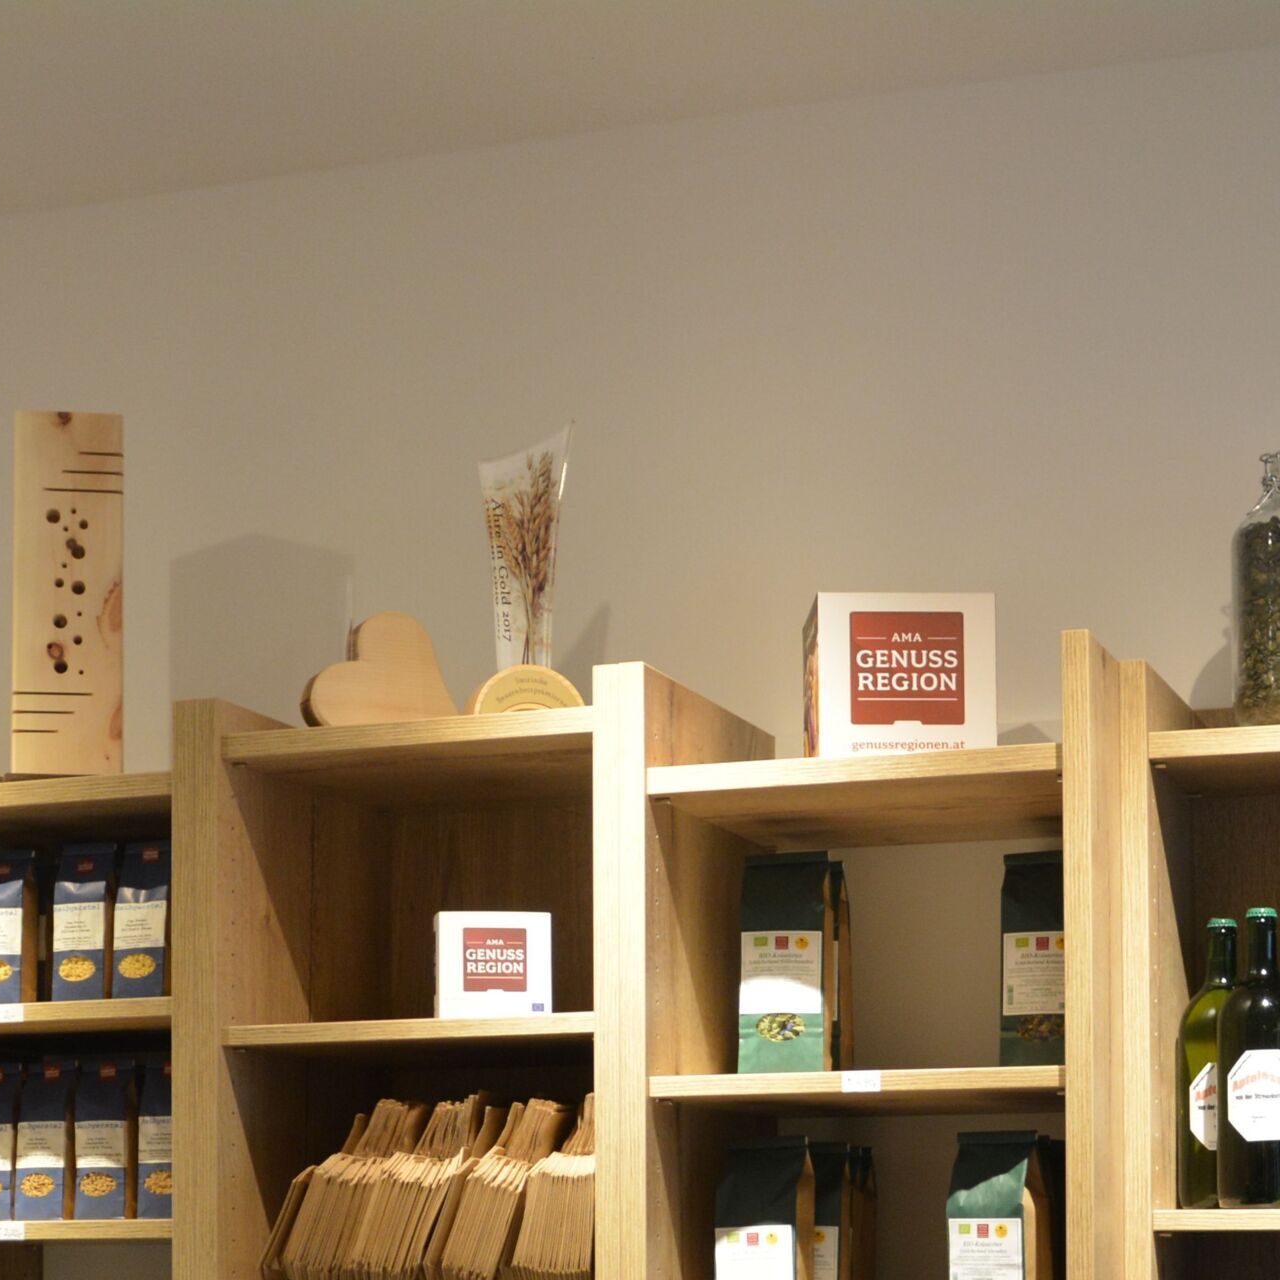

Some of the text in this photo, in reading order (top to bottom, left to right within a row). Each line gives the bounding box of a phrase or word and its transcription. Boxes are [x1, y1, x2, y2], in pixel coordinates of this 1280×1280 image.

[891, 632, 923, 642] AMA
[856, 650, 958, 668] GENUSS
[857, 672, 957, 691] REGION
[851, 740, 965, 752] genussregionen.at
[465, 949, 524, 960] GENUSS
[466, 962, 524, 973] REGION
